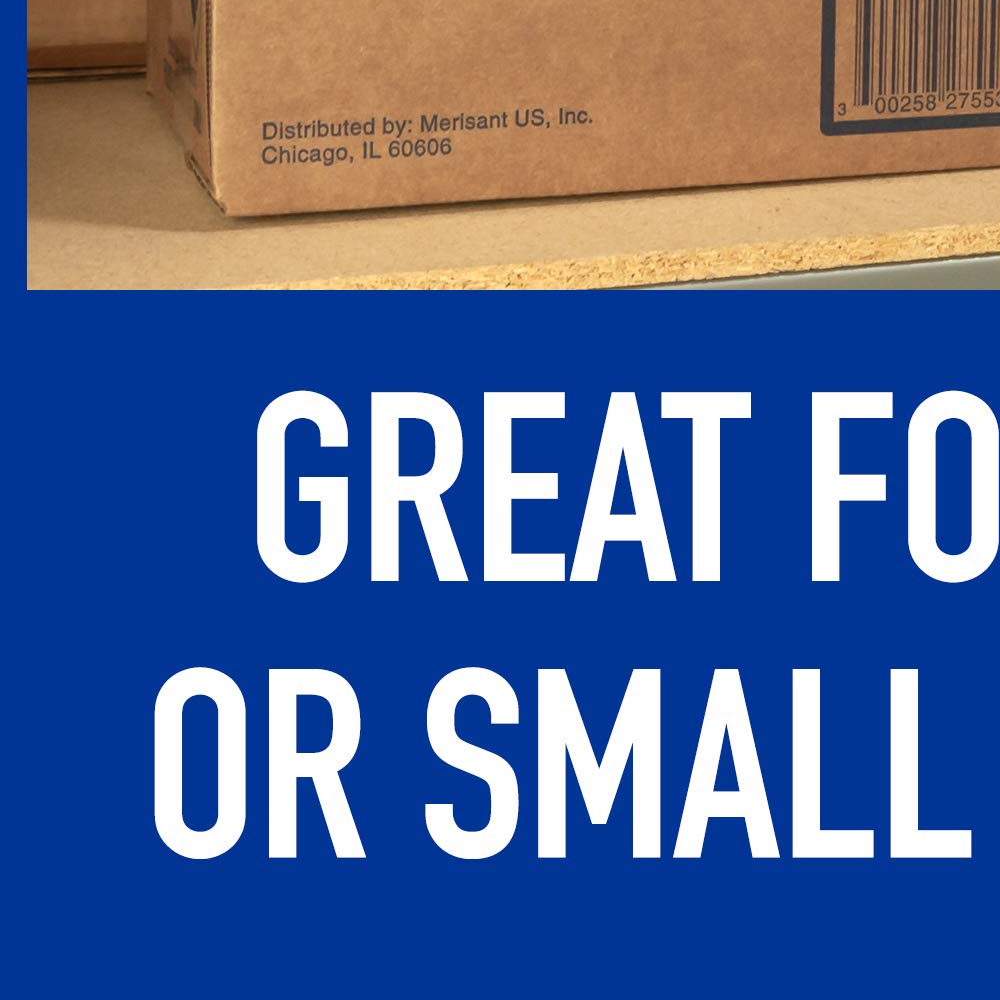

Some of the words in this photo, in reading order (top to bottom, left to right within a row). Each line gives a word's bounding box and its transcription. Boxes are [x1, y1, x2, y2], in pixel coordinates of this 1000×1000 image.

[838, 103, 847, 116] 3
[874, 94, 937, 114] 00258
[262, 117, 376, 140] Distributed
[382, 117, 413, 138] by:
[420, 111, 508, 133] Merisant
[515, 108, 551, 129] US,
[559, 107, 593, 125] Inc.
[262, 144, 354, 167] Chicago,
[363, 140, 381, 159] IL
[388, 137, 452, 157] 60606
